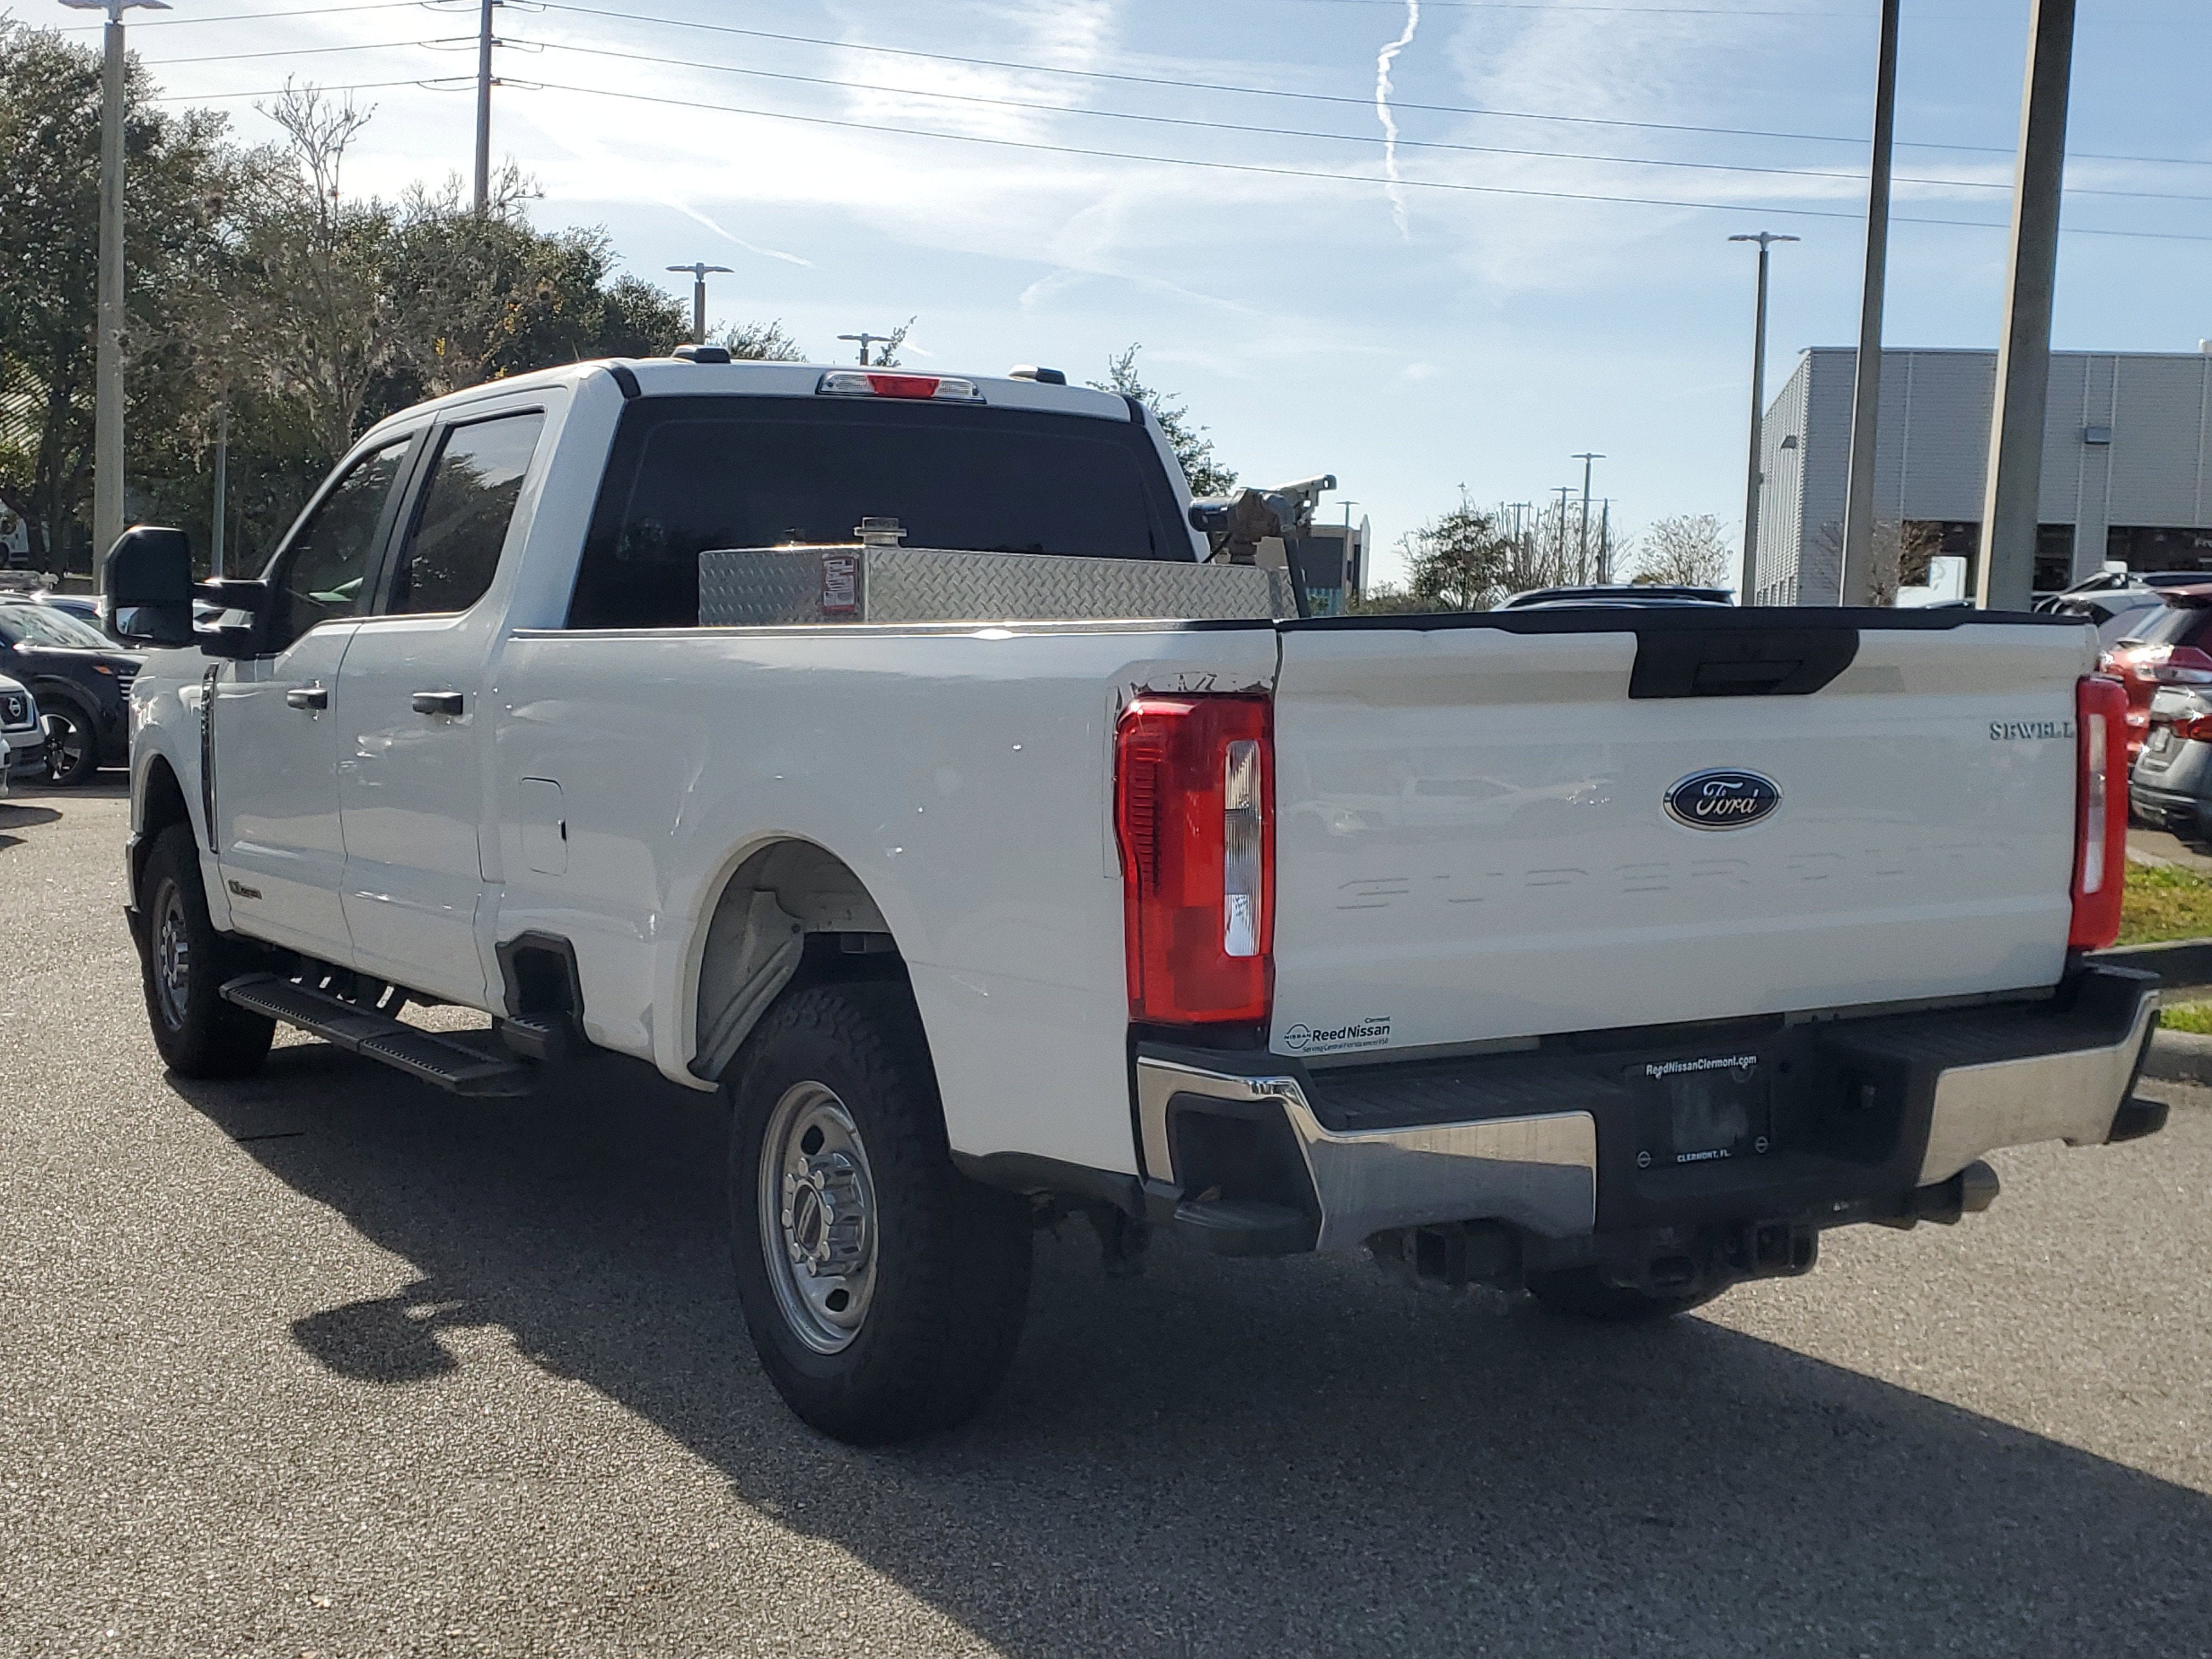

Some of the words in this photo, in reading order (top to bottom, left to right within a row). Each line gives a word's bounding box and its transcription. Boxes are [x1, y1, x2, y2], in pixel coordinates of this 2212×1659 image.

[1990, 721, 2075, 741] SEWELL
[1696, 781, 1759, 816] Ford
[1312, 1026, 1346, 1042] Reed
[1347, 1024, 1390, 1039] Nissan
[1646, 1056, 1756, 1076] ReedNissanClermont.com
